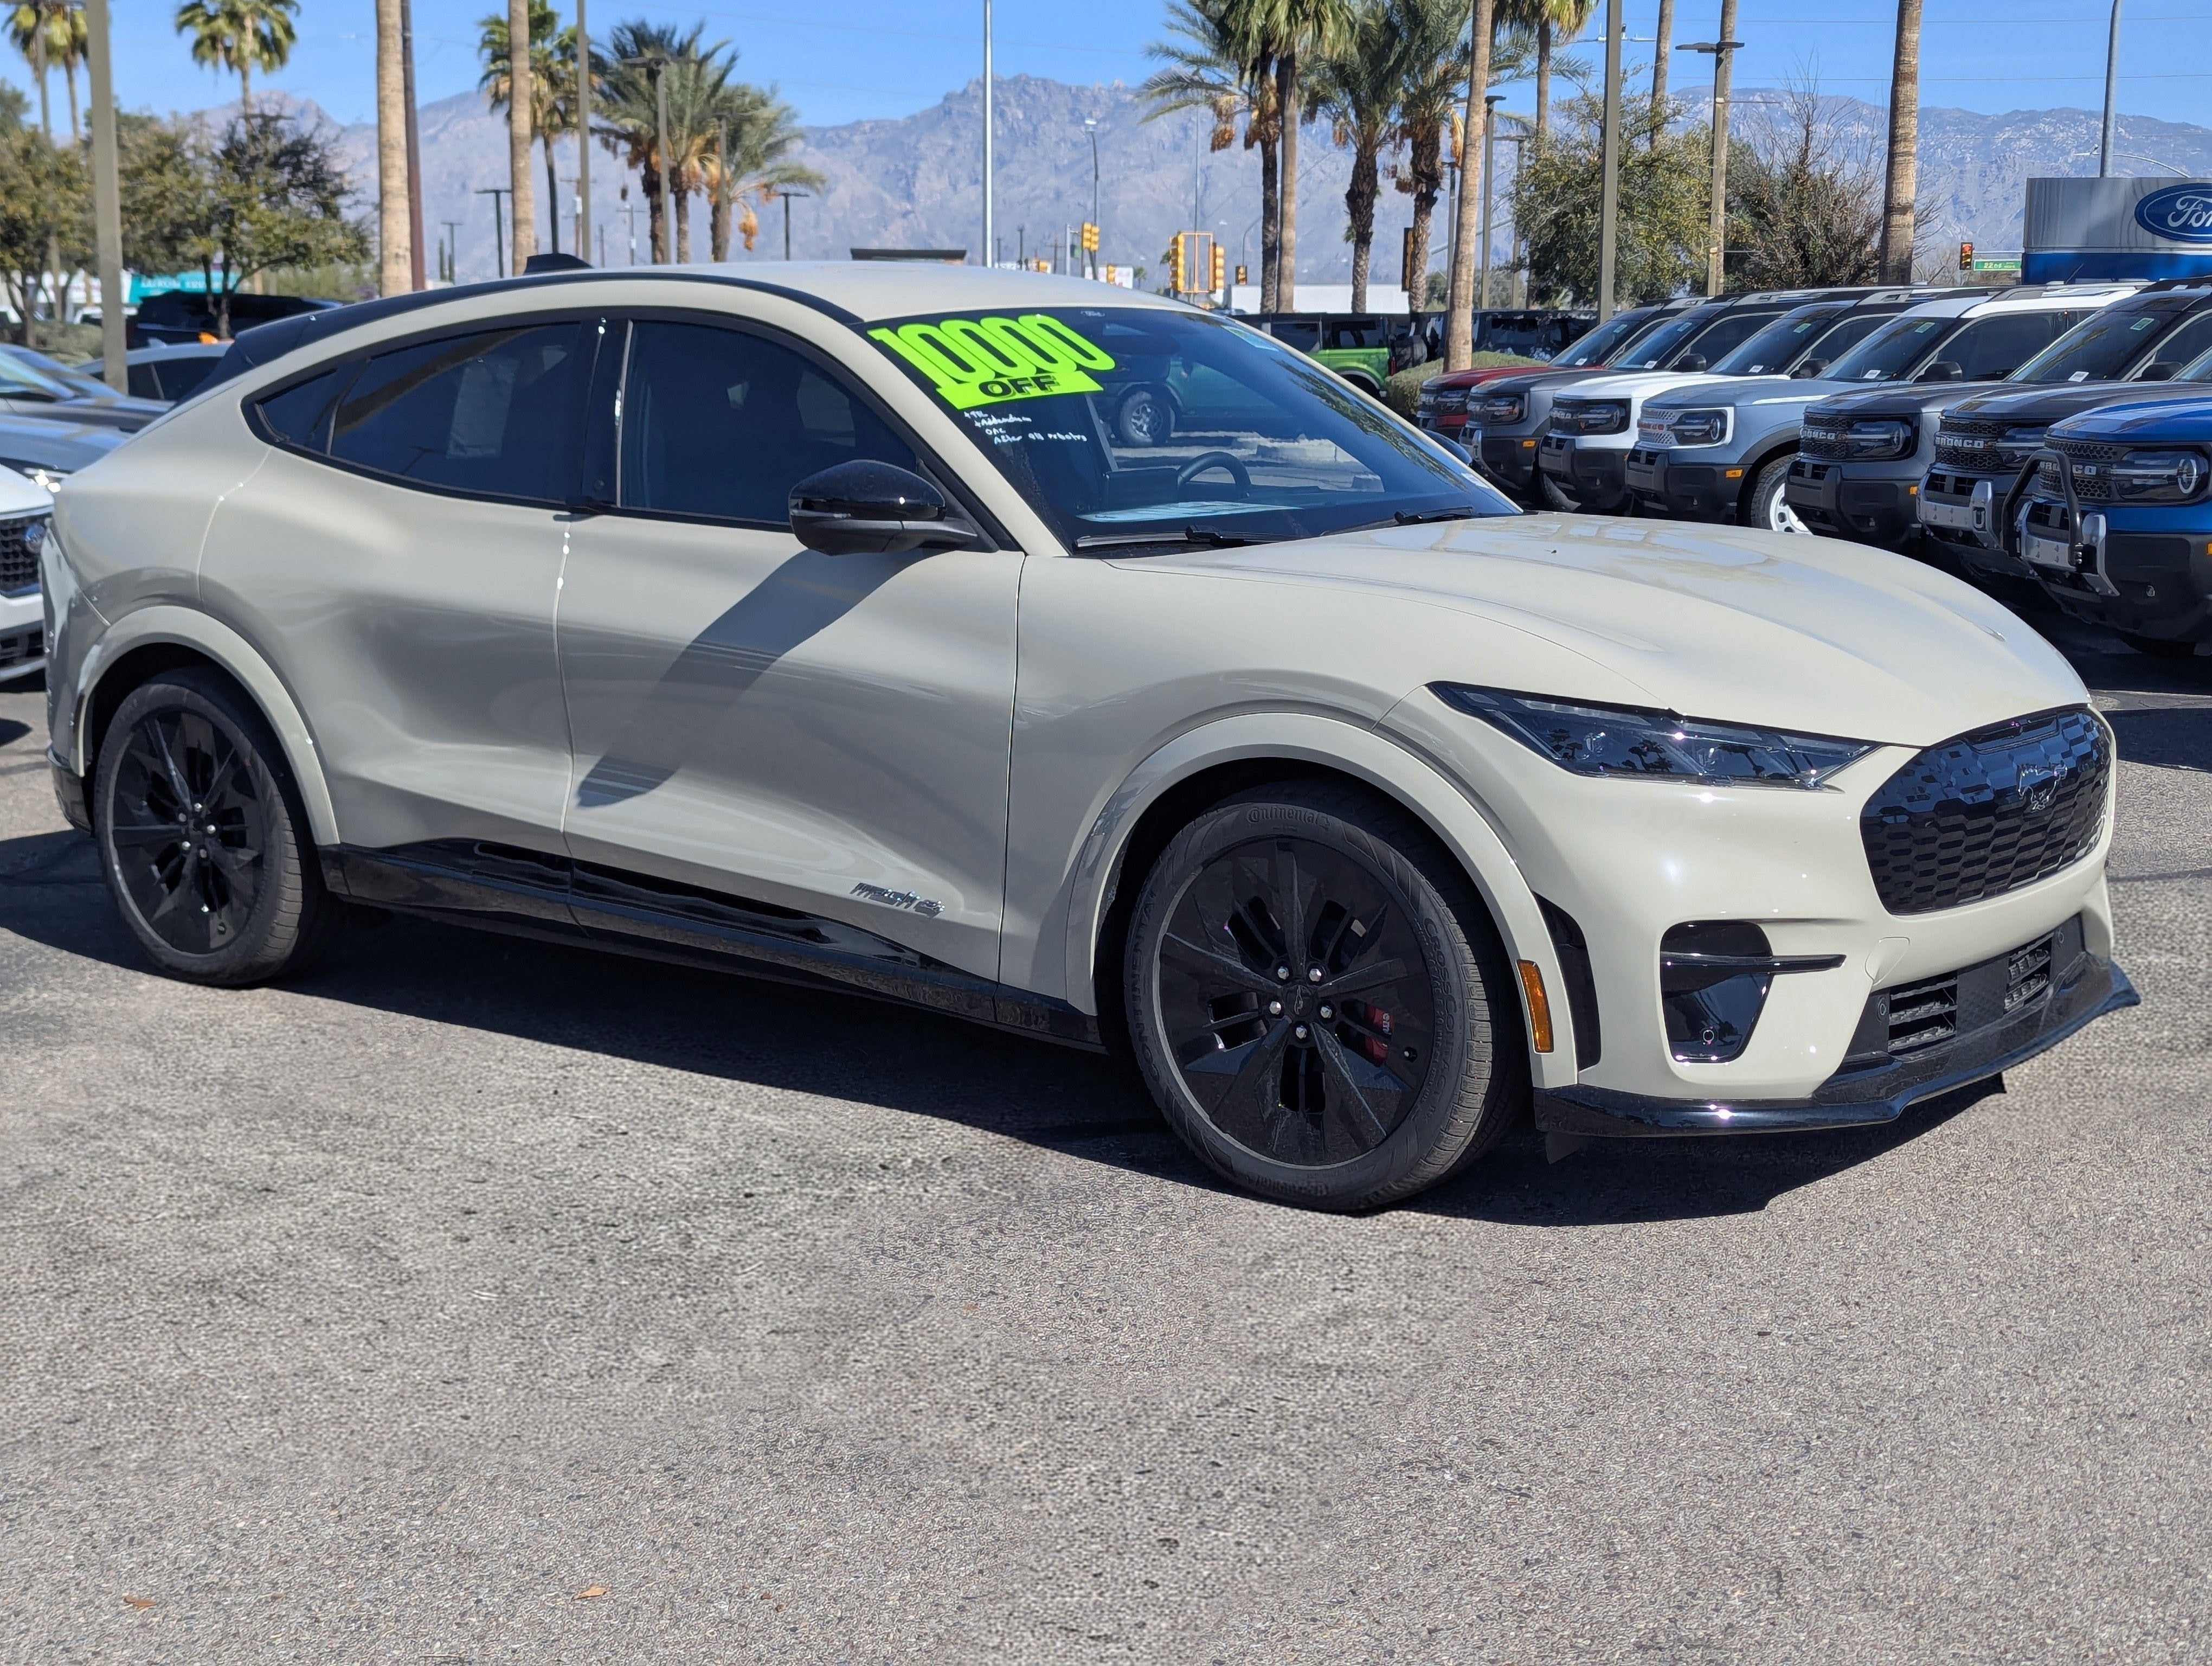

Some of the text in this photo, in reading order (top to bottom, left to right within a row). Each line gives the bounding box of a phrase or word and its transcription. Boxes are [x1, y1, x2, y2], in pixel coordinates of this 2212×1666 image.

[2168, 195, 2212, 227] For
[867, 315, 1116, 389] 10000
[979, 374, 1059, 398] OFF
